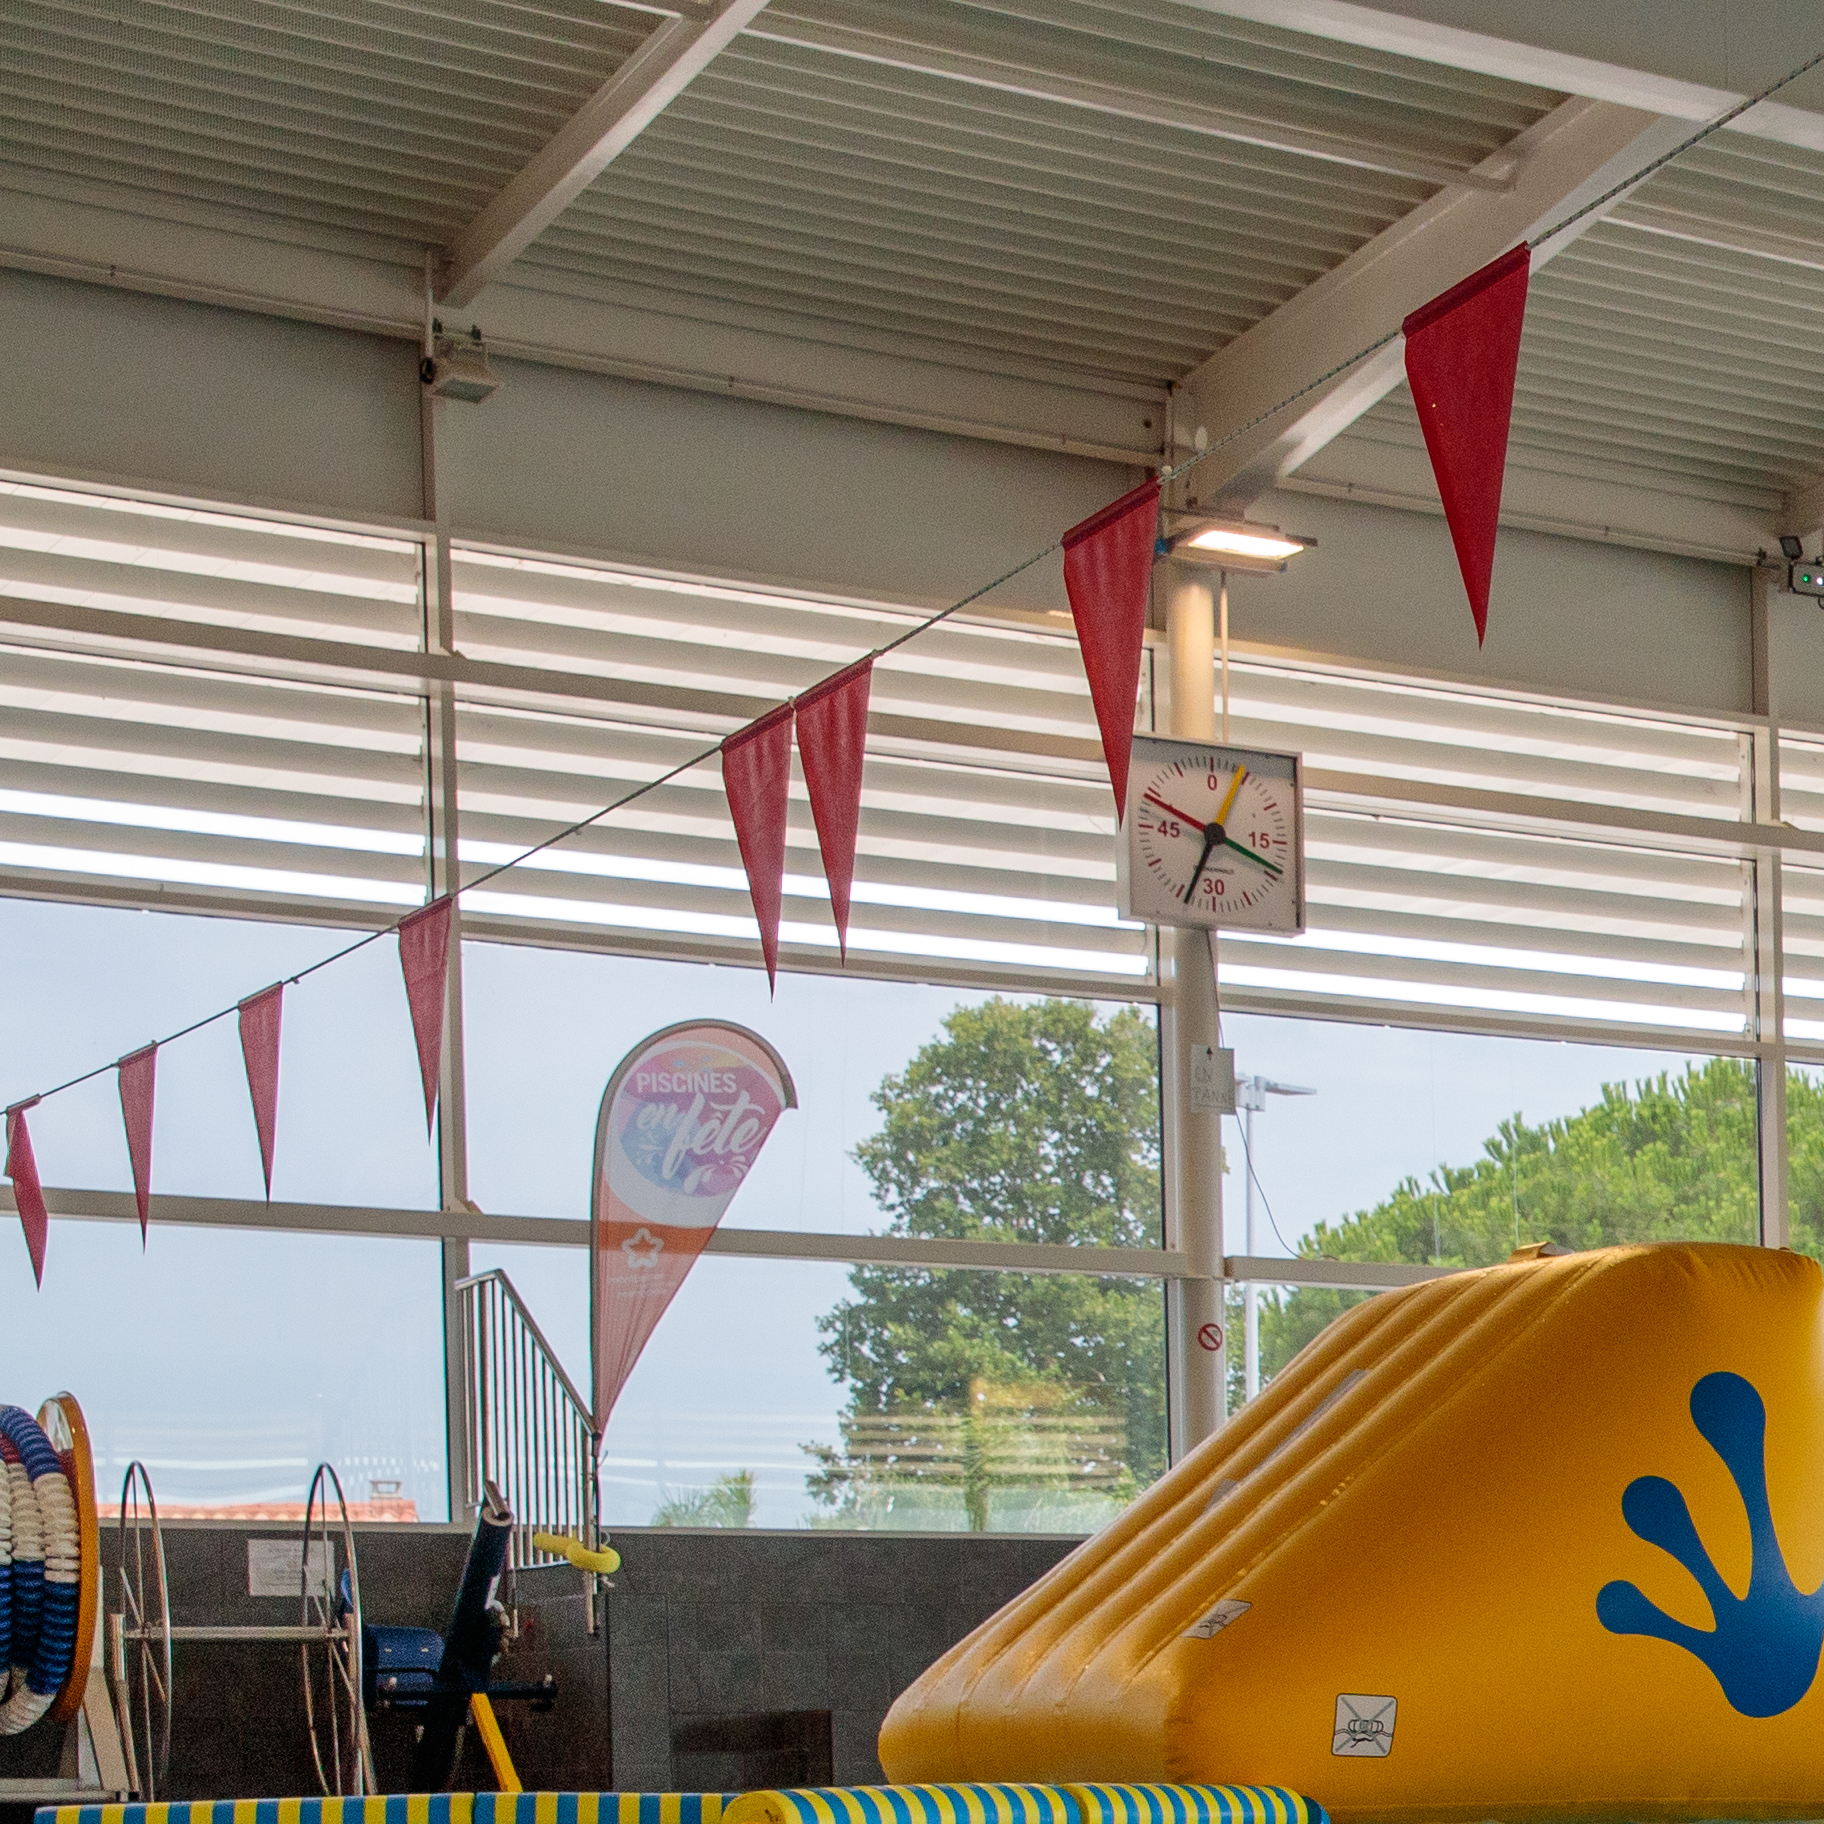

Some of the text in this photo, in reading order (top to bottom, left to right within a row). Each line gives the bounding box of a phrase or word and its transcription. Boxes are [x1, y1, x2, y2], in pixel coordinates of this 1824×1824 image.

[1207, 774, 1217, 791] 0
[1157, 820, 1181, 838] 45
[1248, 832, 1270, 849] 15
[1203, 878, 1225, 896] 30
[637, 1072, 738, 1094] PISCINES
[637, 1090, 773, 1180] en fête
